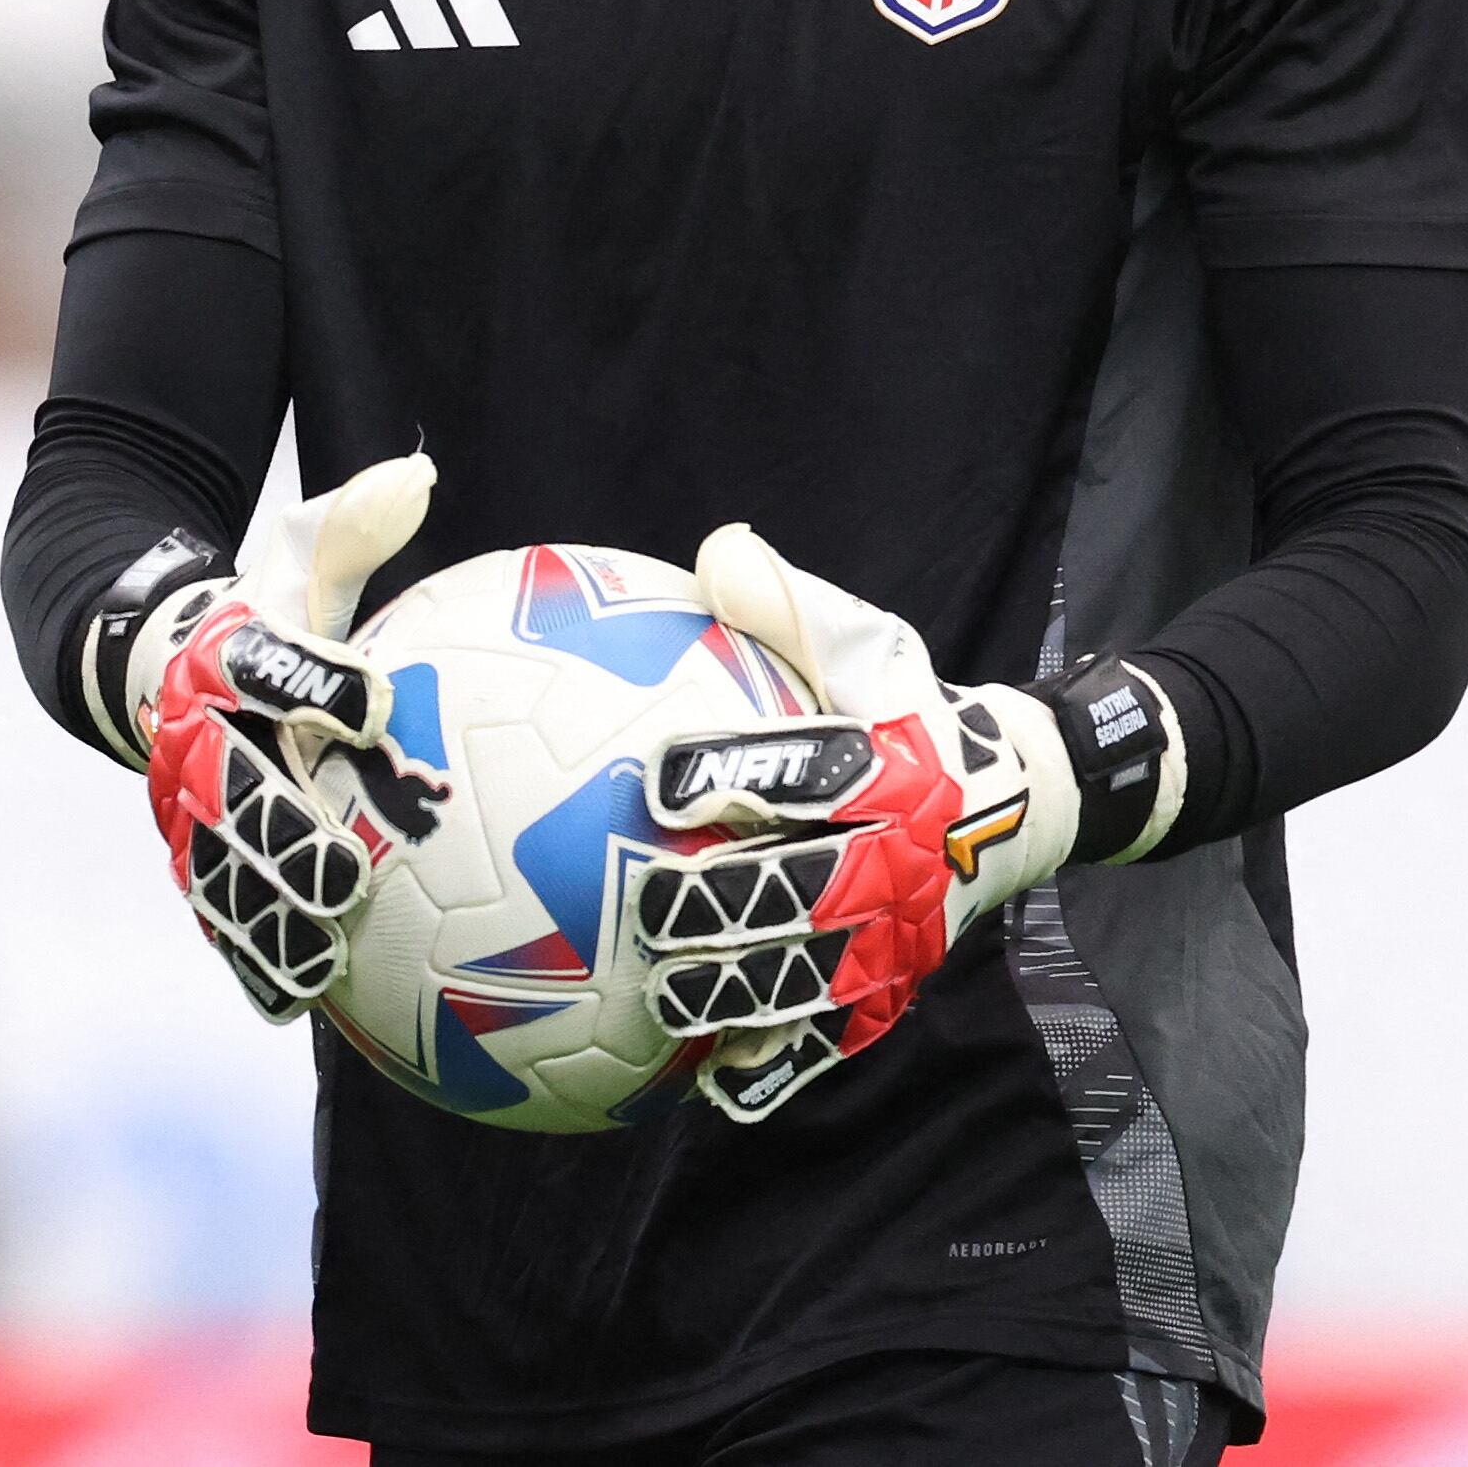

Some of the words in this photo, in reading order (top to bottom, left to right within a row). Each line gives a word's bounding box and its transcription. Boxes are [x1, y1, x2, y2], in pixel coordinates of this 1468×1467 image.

[255, 645, 346, 707] RIN
[1088, 685, 1139, 726] PATRIK
[1095, 707, 1149, 749] SEQUEIRA
[685, 743, 818, 791] NAT
[948, 1237, 1047, 1258] AEROREADY
